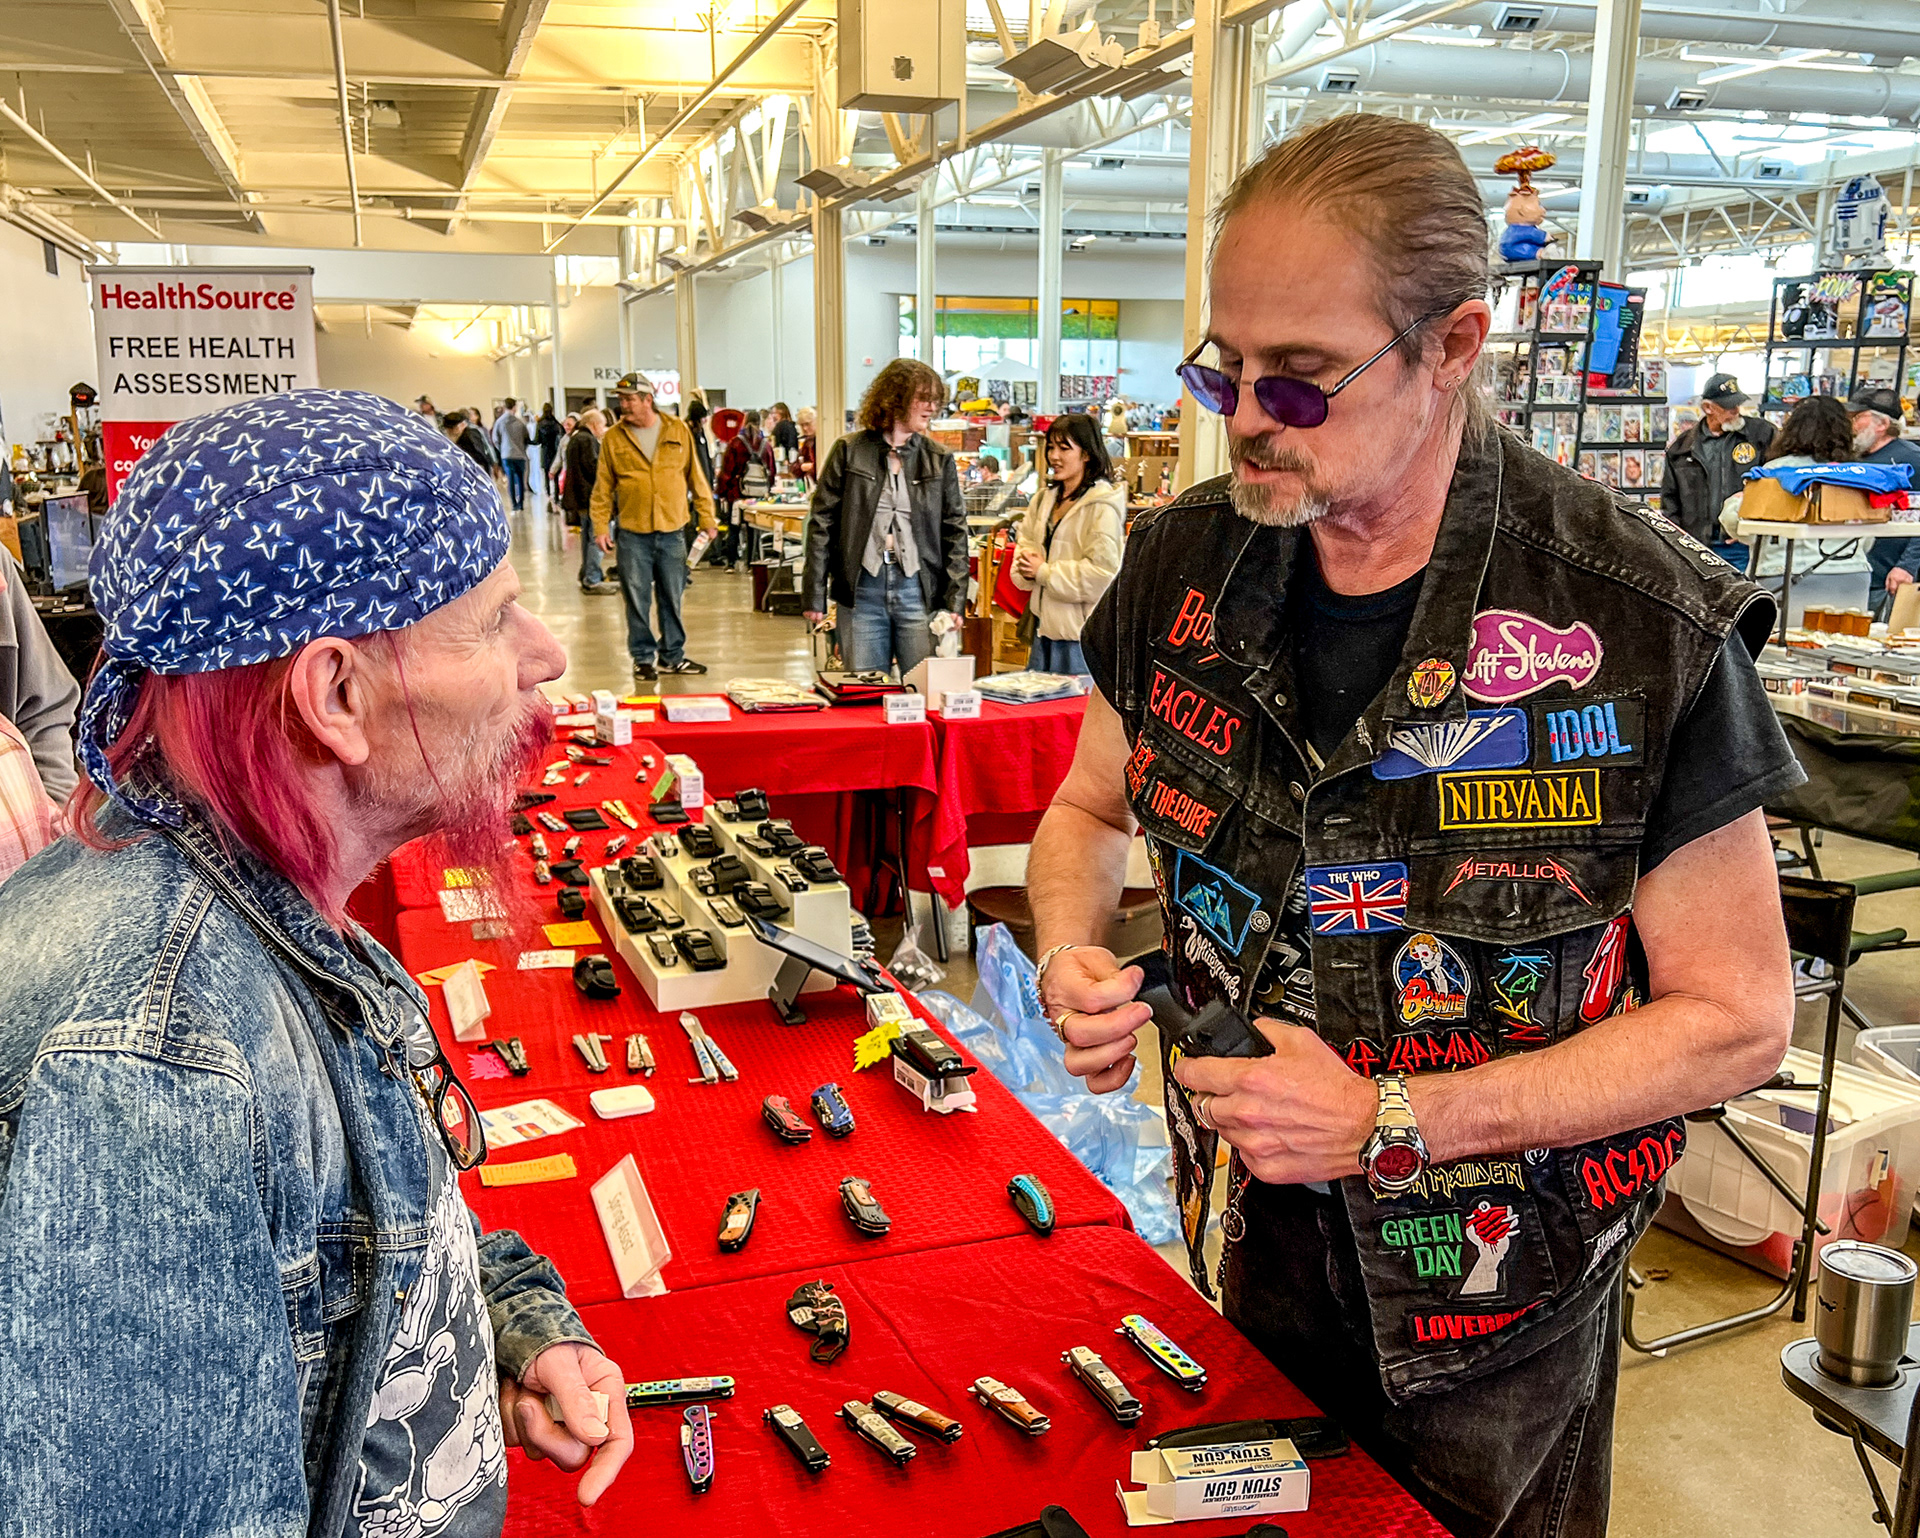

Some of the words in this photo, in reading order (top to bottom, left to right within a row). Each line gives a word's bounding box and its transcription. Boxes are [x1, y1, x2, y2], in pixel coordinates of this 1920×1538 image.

[109, 336, 179, 358] FREE
[189, 336, 294, 359] HEALTH
[113, 373, 297, 394] ASSESSMENT
[1498, 620, 1596, 682] Stevens
[1150, 670, 1242, 756] EAGLES
[1546, 702, 1633, 763] IDOL
[1446, 776, 1593, 822] NIRVANA
[1328, 872, 1349, 884] THE
[1352, 870, 1381, 882] WHO
[1443, 856, 1592, 906] METALLICA
[1400, 977, 1467, 1021] BOWIE
[1332, 1039, 1382, 1079] EF
[1387, 1031, 1490, 1075] LEPPARD
[1427, 1162, 1526, 1199] MAIDEN
[618, 1220, 634, 1256] Assist
[1382, 1212, 1463, 1246] GREEN
[1414, 1245, 1462, 1278] DAY
[1192, 1451, 1226, 1463] GUN
[1231, 1447, 1272, 1459] STUN
[1204, 1481, 1237, 1498] GUN
[1242, 1477, 1282, 1494] STUN
